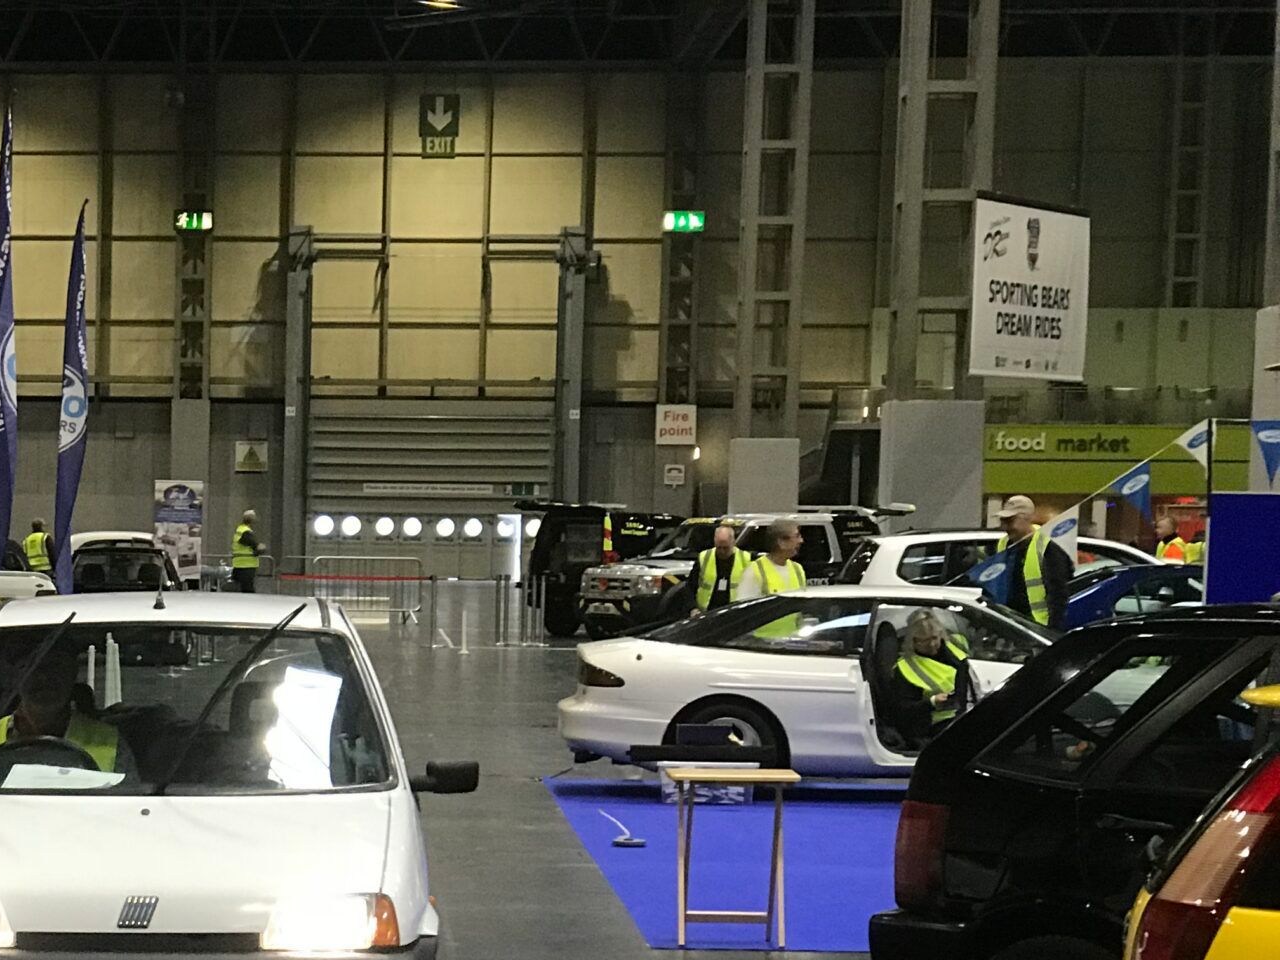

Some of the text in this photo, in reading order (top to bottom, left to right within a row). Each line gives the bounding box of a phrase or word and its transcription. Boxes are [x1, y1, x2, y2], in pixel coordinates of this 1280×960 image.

[426, 136, 454, 153] EXIT
[989, 279, 1071, 310] SPORTING BEARS
[996, 311, 1062, 340] DREAM RIDES
[664, 410, 689, 422] Fire
[660, 426, 693, 438] point
[995, 431, 1130, 453] food market
